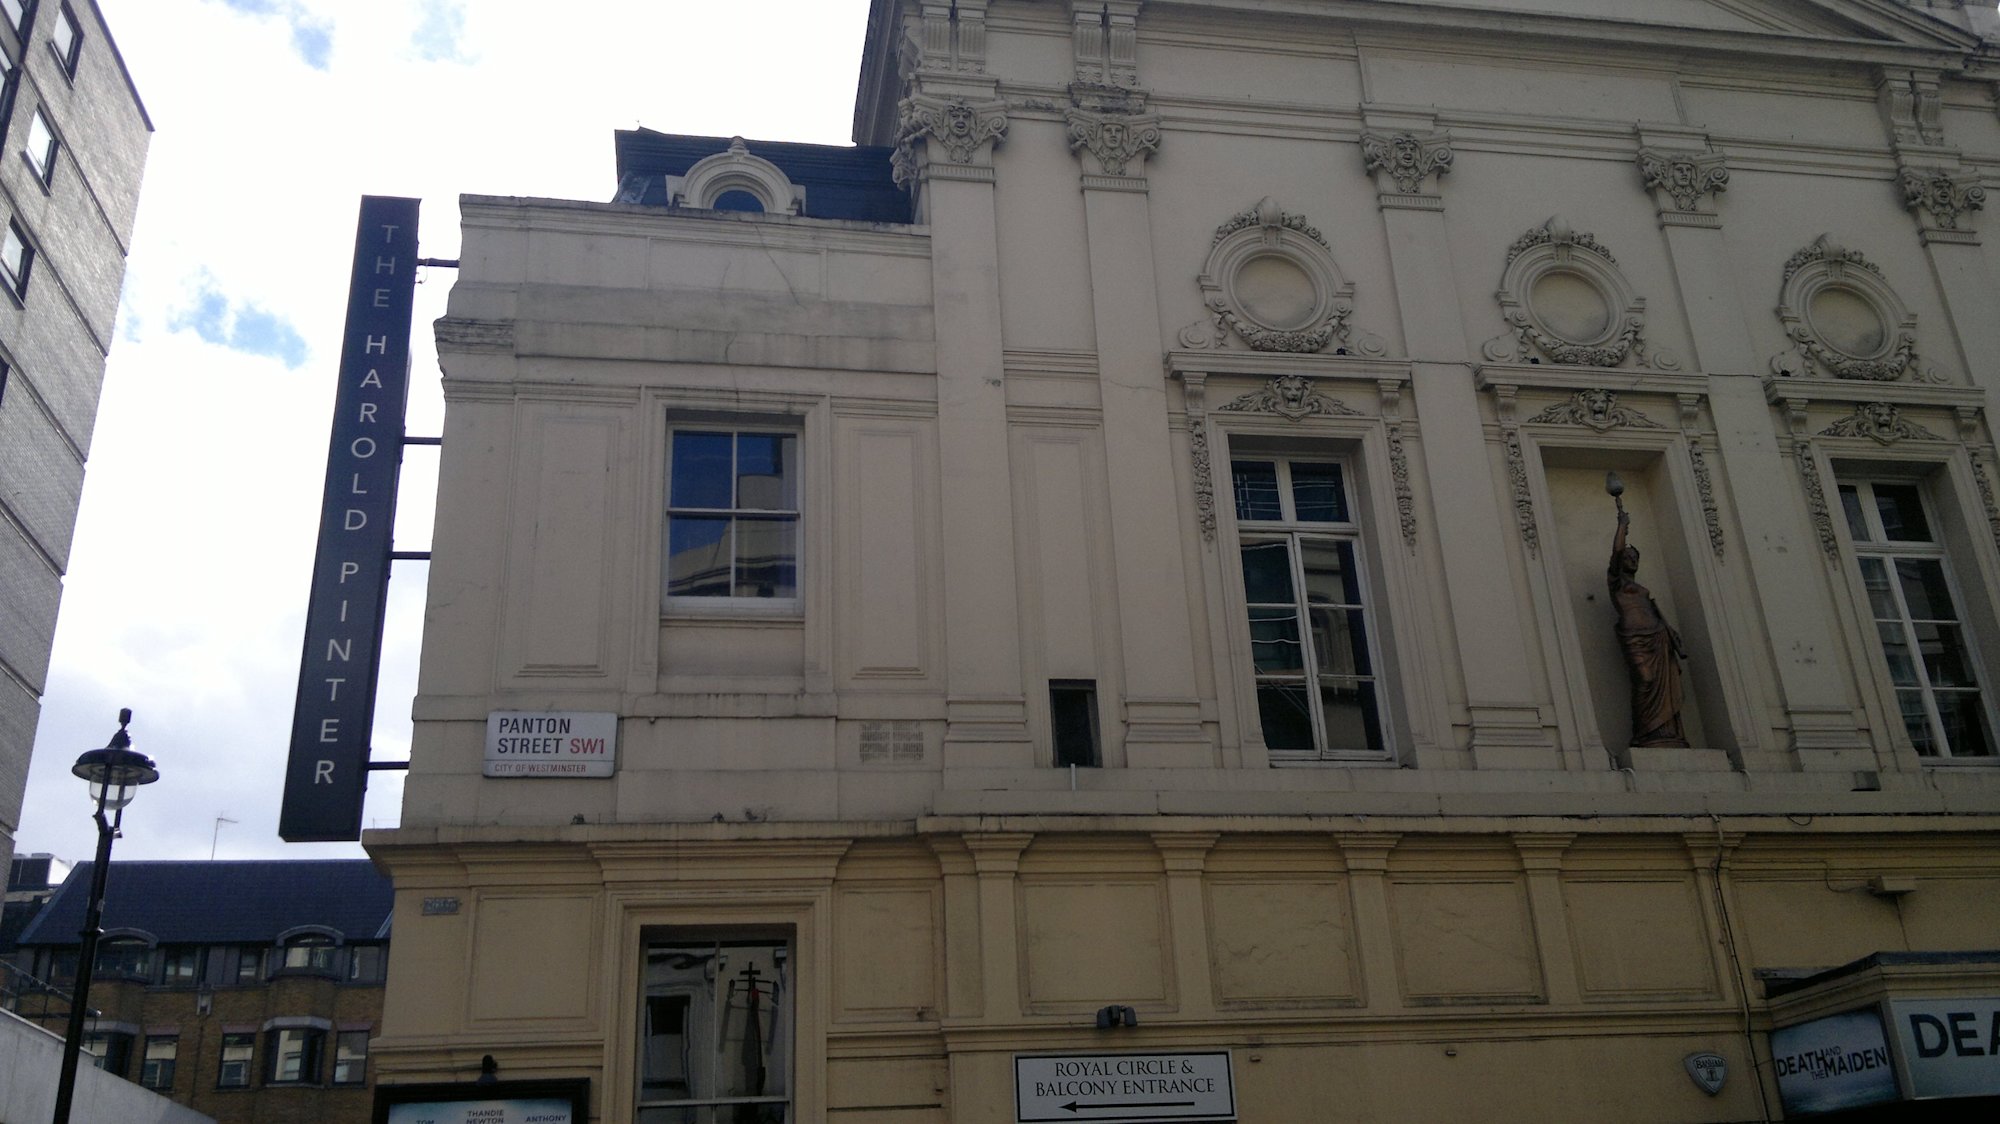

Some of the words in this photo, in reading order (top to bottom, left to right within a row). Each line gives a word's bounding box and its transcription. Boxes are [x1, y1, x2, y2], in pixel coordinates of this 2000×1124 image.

[374, 224, 400, 307] THE
[344, 334, 387, 531] HAROLD
[314, 561, 360, 785] PINTER
[498, 718, 571, 734] PANTON
[497, 737, 563, 754] STREET
[569, 738, 606, 754] SW1
[494, 763, 513, 772] CITY
[515, 763, 526, 772] OF
[528, 763, 587, 773] WESTMINSTER
[1909, 1011, 2000, 1058] DE
[1055, 1061, 1113, 1077] ROYAL
[1116, 1060, 1176, 1075] CIRCLE
[1181, 1059, 1195, 1074] &
[1777, 1050, 1826, 1077] DEATH
[1825, 1046, 1841, 1057] AND
[1811, 1069, 1825, 1080] THE
[1824, 1047, 1888, 1078] MAIDEN
[1035, 1080, 1118, 1097] BALCONY
[1123, 1078, 1216, 1094] ENTRANCE
[525, 1114, 567, 1122] ANTHONY
